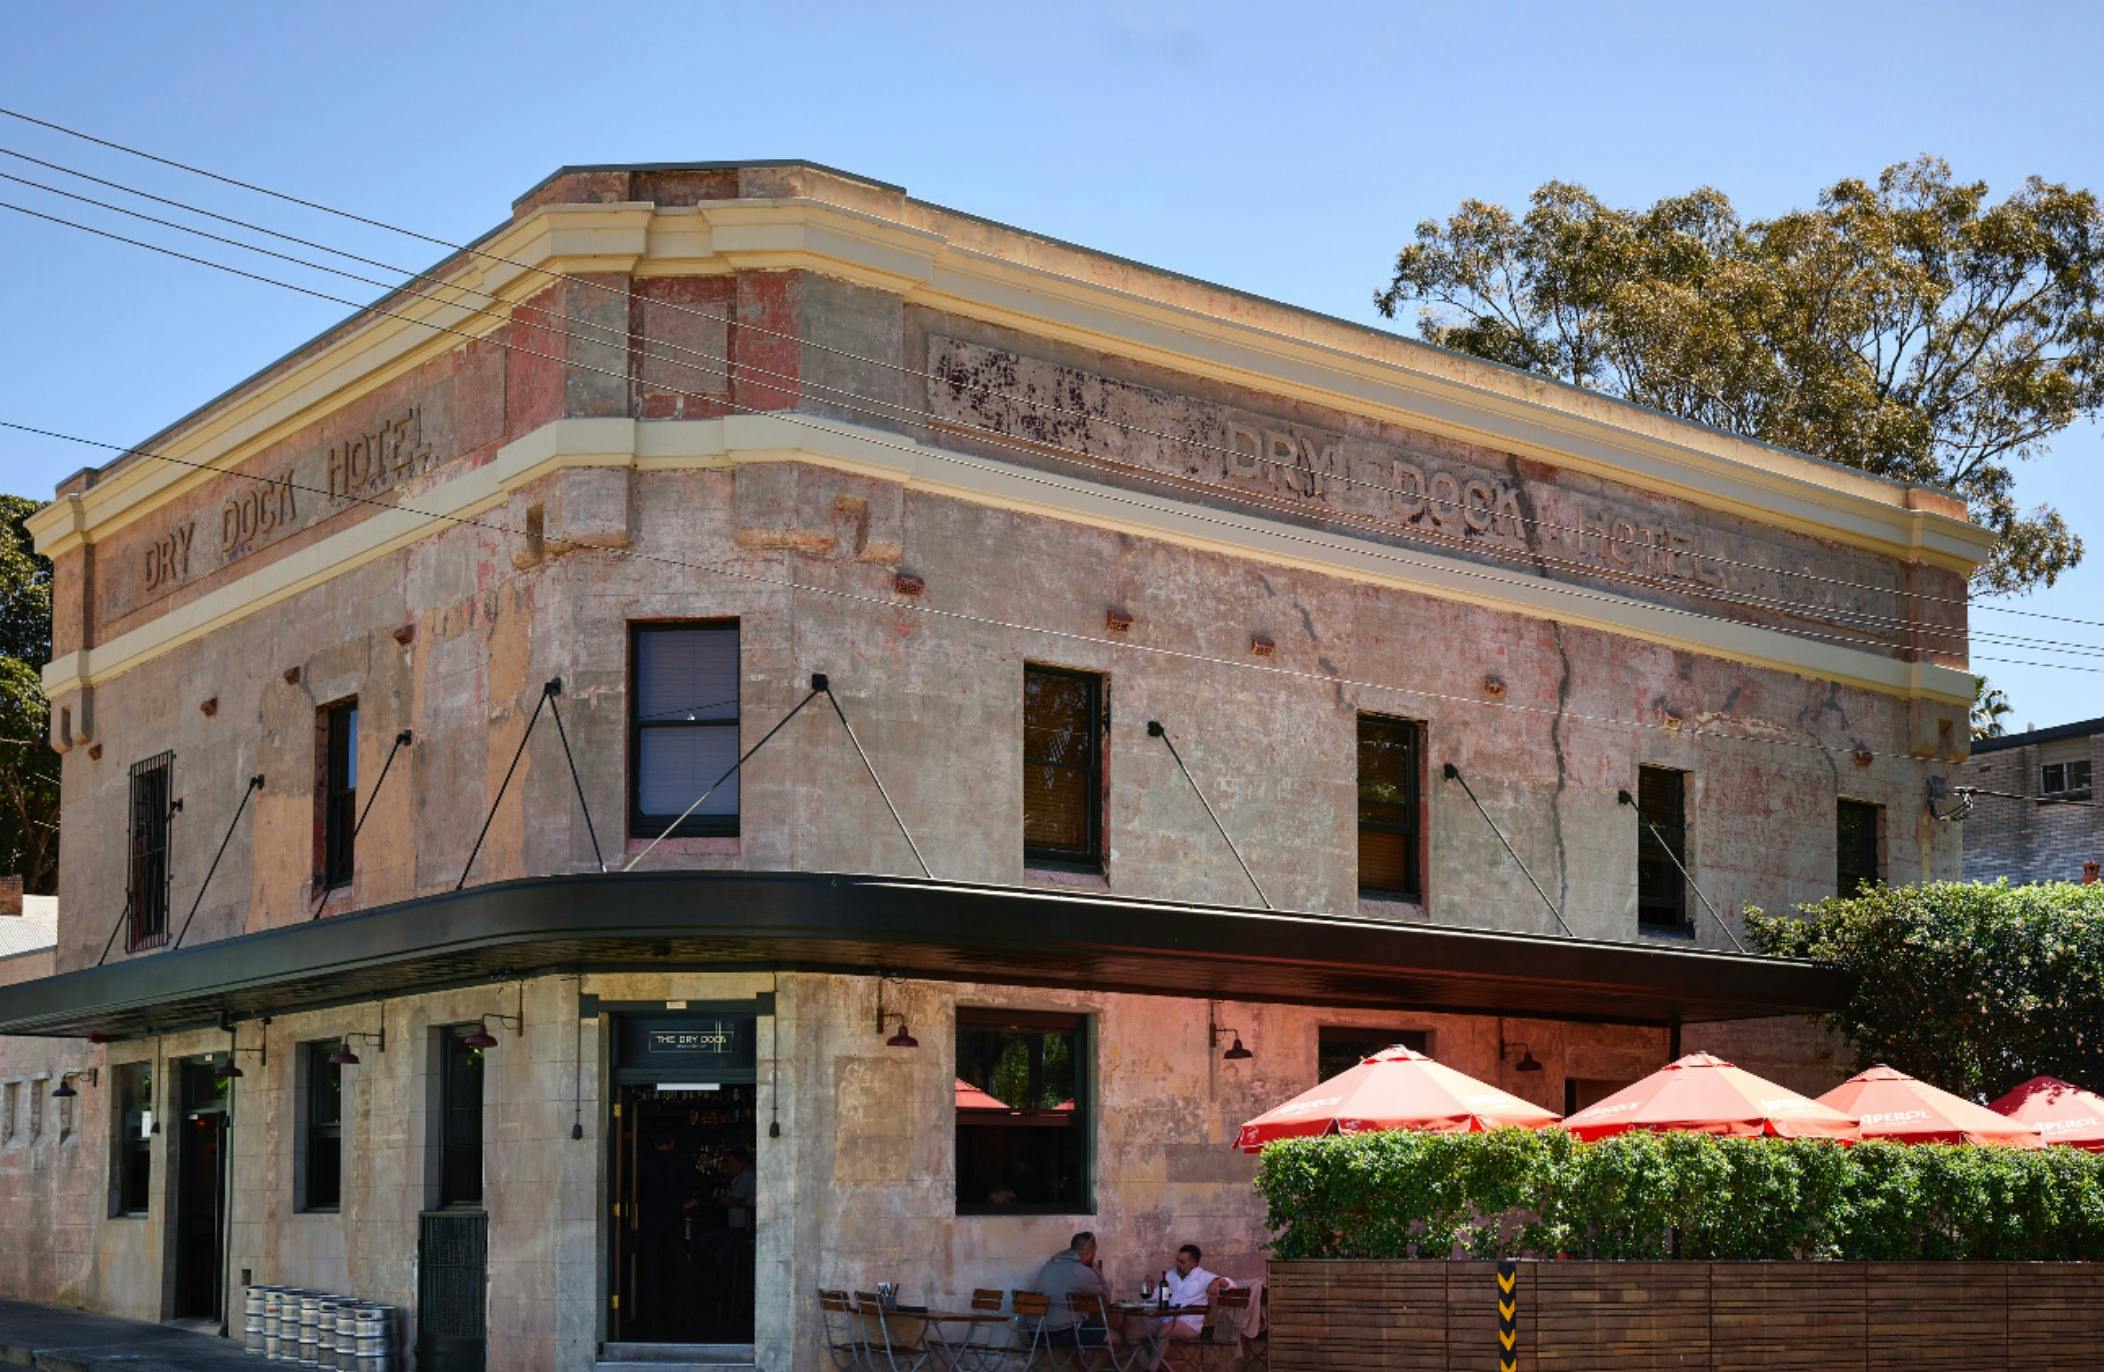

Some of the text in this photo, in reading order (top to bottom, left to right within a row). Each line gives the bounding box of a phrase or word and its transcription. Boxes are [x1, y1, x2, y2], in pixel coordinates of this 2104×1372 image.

[1226, 420, 1333, 498] DRY
[1392, 460, 1527, 541] DOCK
[145, 402, 433, 592] DRY DOCK HOTEL
[656, 1035, 676, 1044] THE
[679, 1035, 699, 1044] DRY
[1860, 1109, 1932, 1125] APEROL
[2032, 1117, 2101, 1133] APEROL
